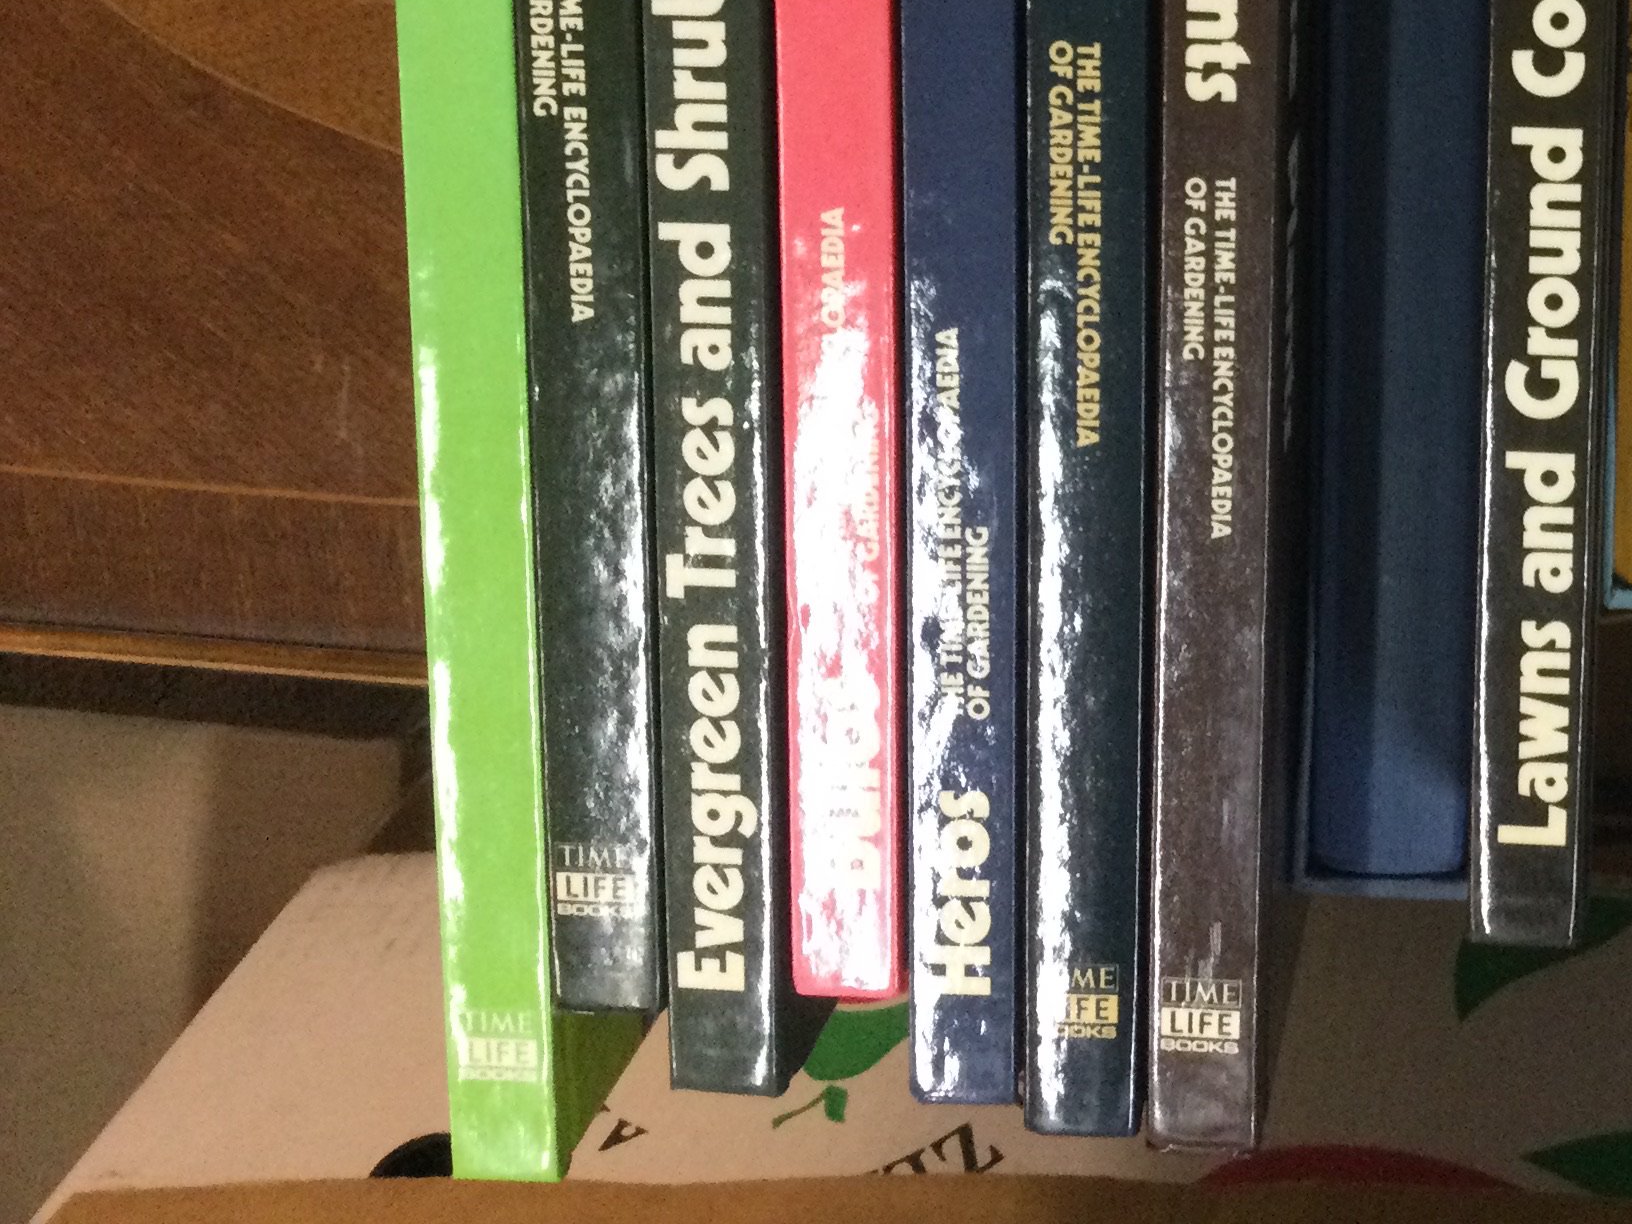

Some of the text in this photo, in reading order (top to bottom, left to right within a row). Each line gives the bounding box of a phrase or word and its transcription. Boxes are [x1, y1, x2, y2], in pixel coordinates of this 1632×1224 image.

[563, 106, 595, 323] ENCYCLOPAEDIA
[1048, 40, 1074, 247] OF GARDENING
[658, 222, 733, 372] and
[1076, 42, 1102, 448] THE TIME-LIFE ENCYCLOPAEDIA
[1182, 176, 1207, 361] OF GARDENING
[1505, 126, 1584, 420] Ground
[1210, 176, 1237, 540] THE TIME-LIFE ENCYCLOPAEDIA
[666, 397, 737, 600] Trees
[1505, 450, 1576, 594] and
[940, 673, 964, 715] HE
[963, 526, 991, 721] OF GARDENING
[677, 624, 758, 992] Evergreen
[1497, 619, 1571, 847] Lawns
[558, 844, 630, 868] TIME
[566, 875, 627, 900] LIFE
[924, 789, 991, 996] Heros
[465, 1012, 532, 1032] TIME
[469, 1042, 530, 1064] LIFE
[1057, 1025, 1117, 1039] OOKS
[1071, 966, 1116, 990] ME
[1160, 1038, 1239, 1055] BOOKS
[1166, 980, 1240, 1005] TIME
[1170, 1010, 1232, 1036] LIFE
